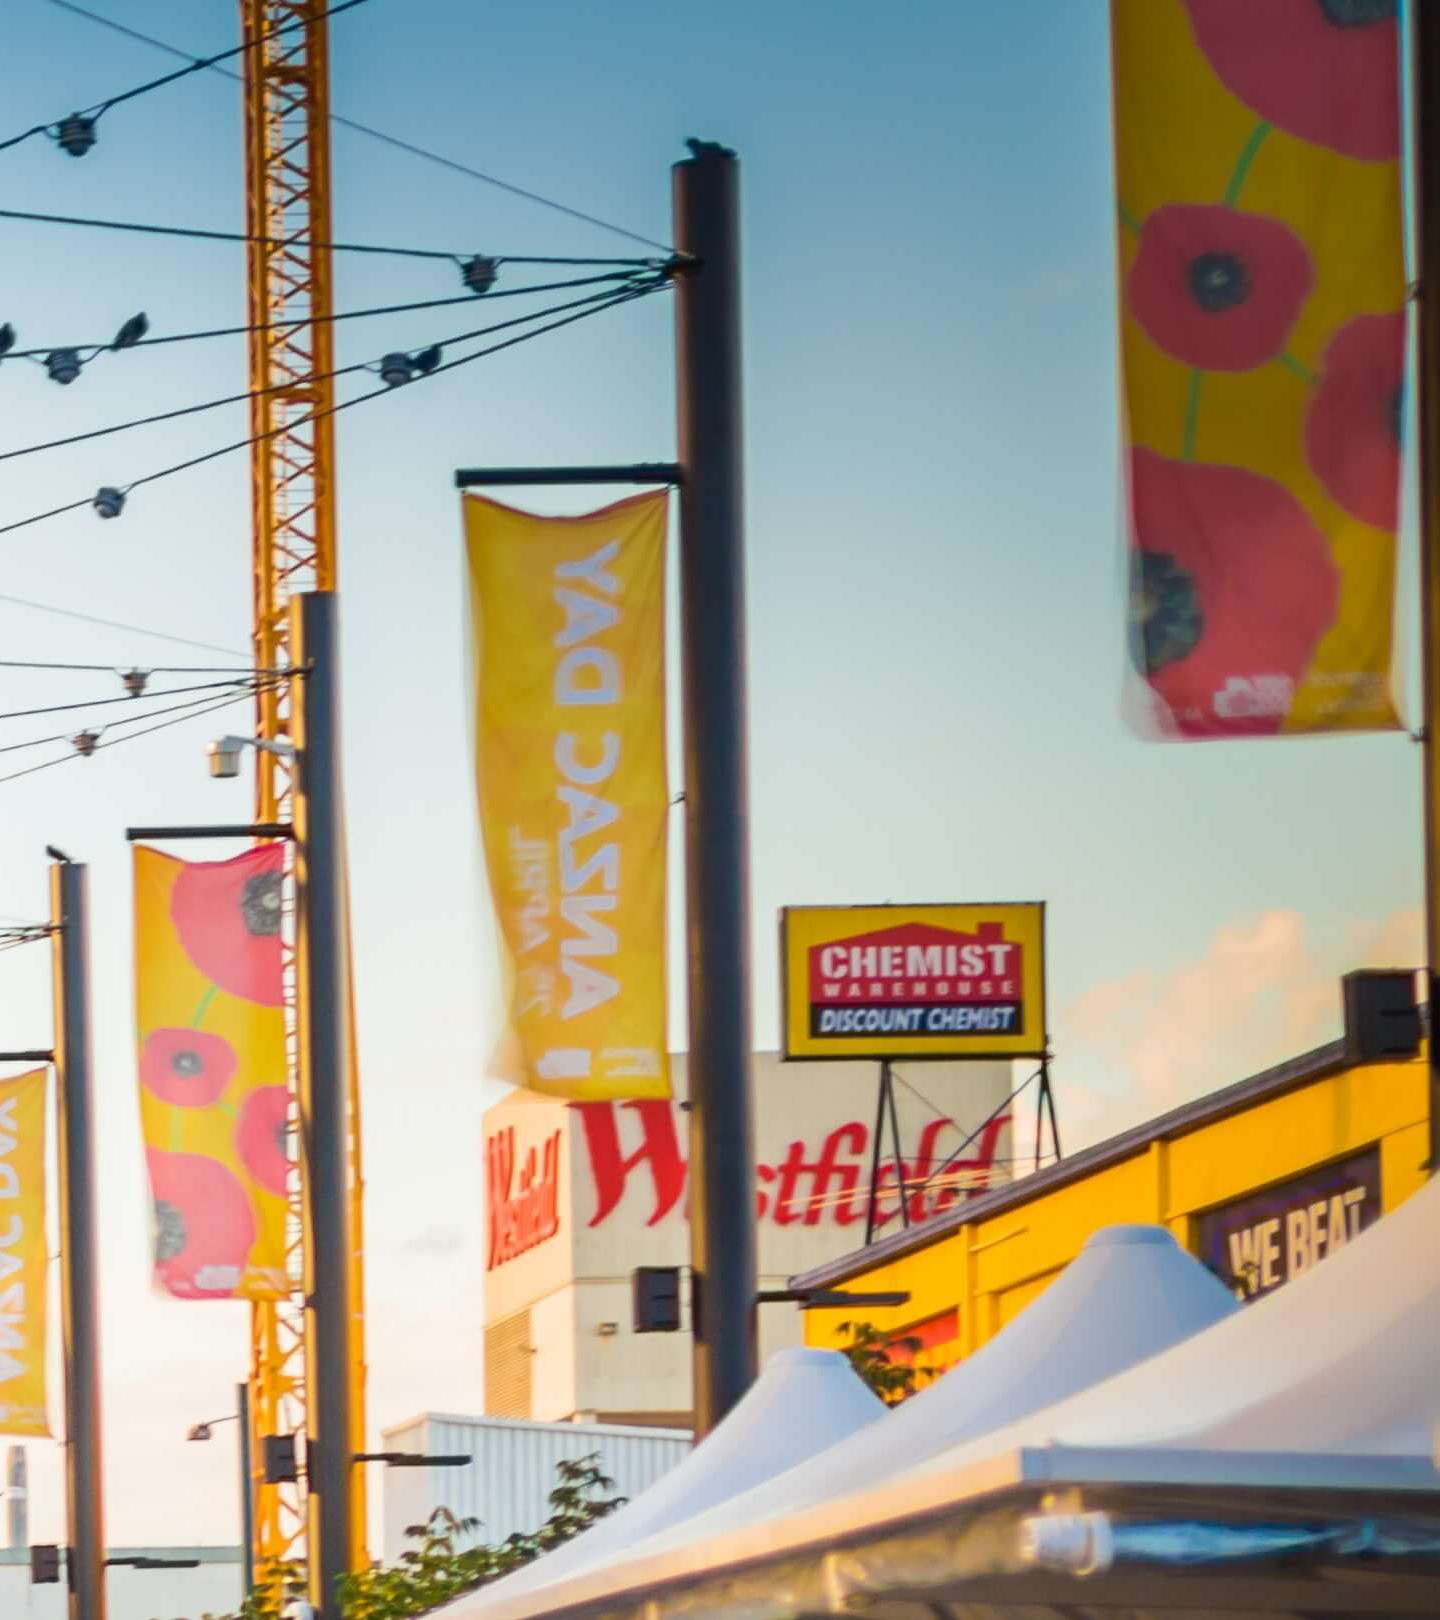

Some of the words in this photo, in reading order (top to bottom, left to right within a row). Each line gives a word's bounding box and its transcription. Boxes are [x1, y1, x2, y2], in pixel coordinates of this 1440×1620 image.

[820, 944, 1013, 979] CHEMIST
[822, 980, 1015, 998] WAREHOUSE
[820, 1007, 924, 1033] DISCOUNT
[926, 1006, 1016, 1030] CHEMIST
[486, 1126, 563, 1272] Westfield
[565, 1099, 1014, 1230] Wstfield
[1229, 1217, 1281, 1301] WE
[1285, 1185, 1367, 1281] BEAT
